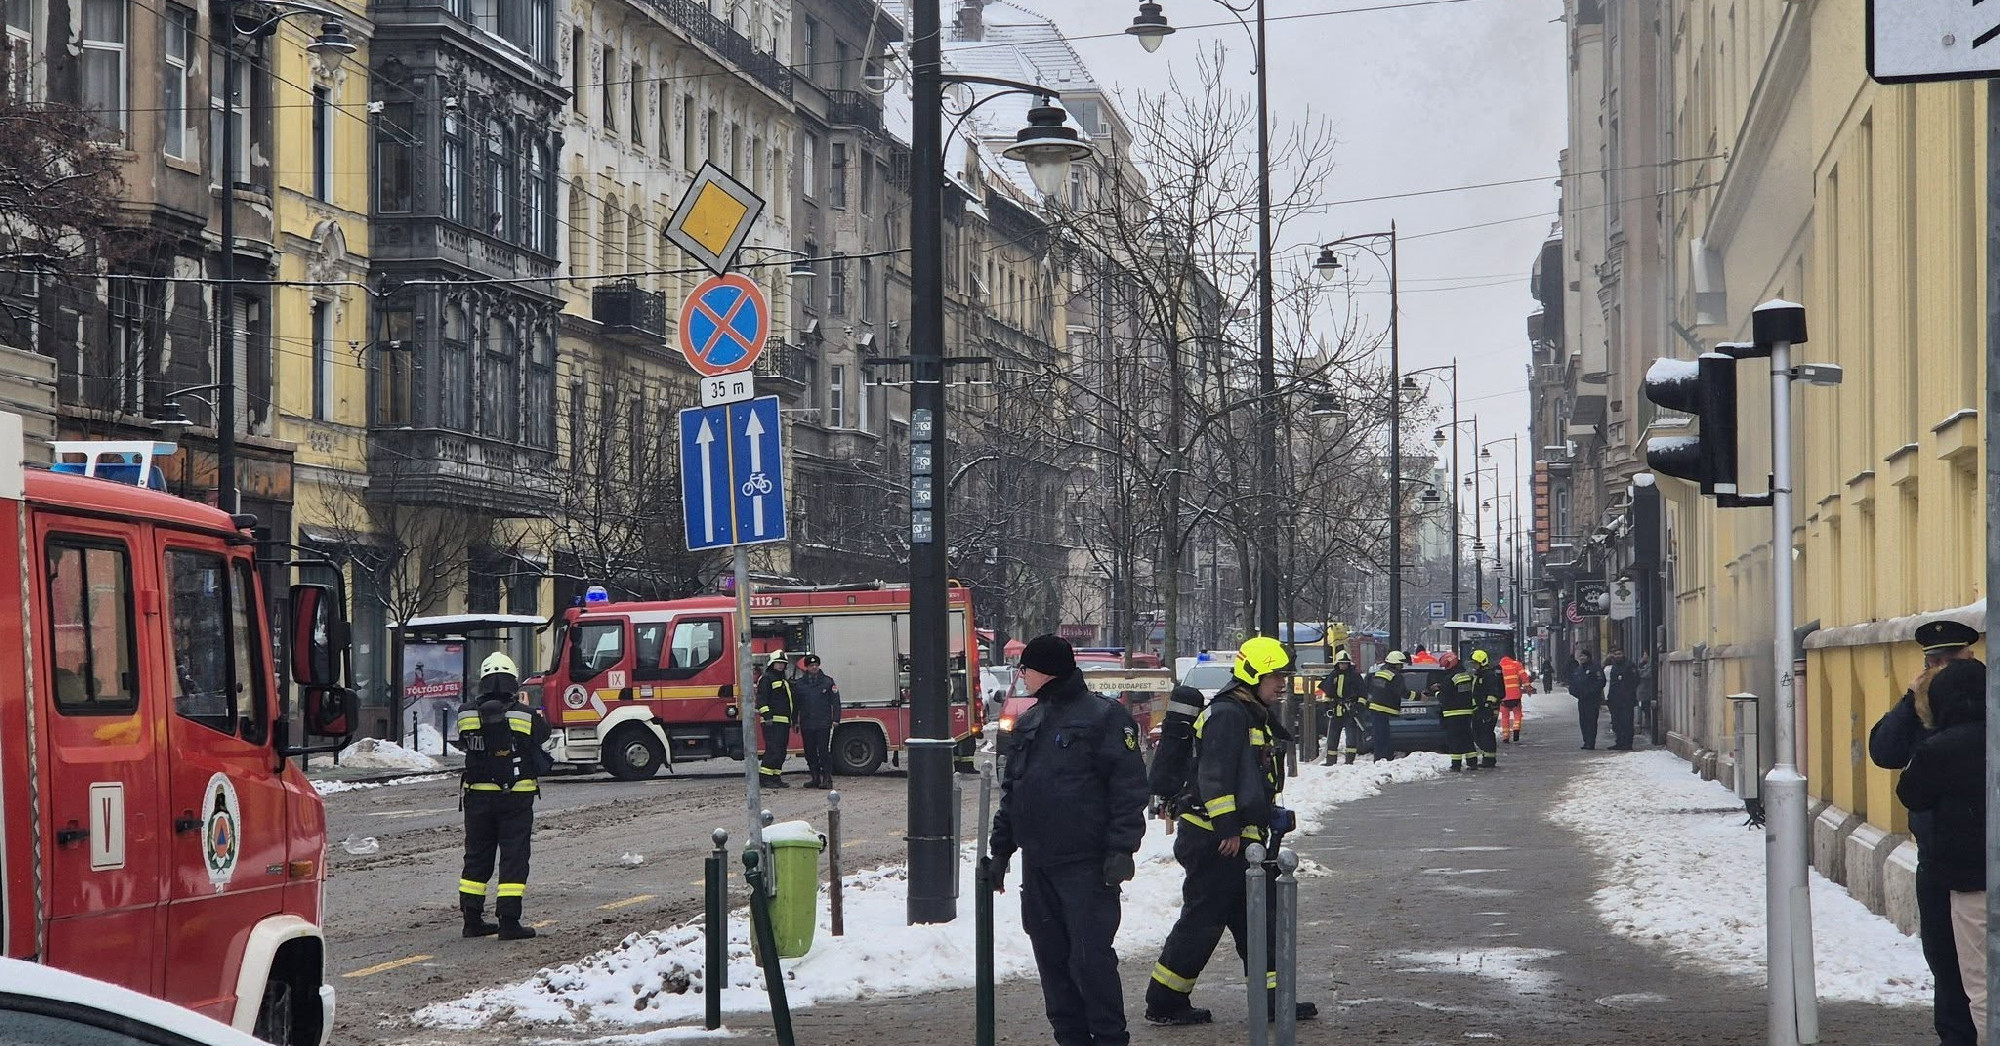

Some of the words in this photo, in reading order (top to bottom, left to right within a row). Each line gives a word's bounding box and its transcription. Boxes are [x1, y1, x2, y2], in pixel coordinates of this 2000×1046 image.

[711, 381, 725, 398] 35
[733, 382, 749, 395] m
[611, 673, 621, 686] IX
[1118, 682, 1152, 690] BUDAPEST
[444, 682, 459, 692] FEL
[102, 797, 112, 854] V
